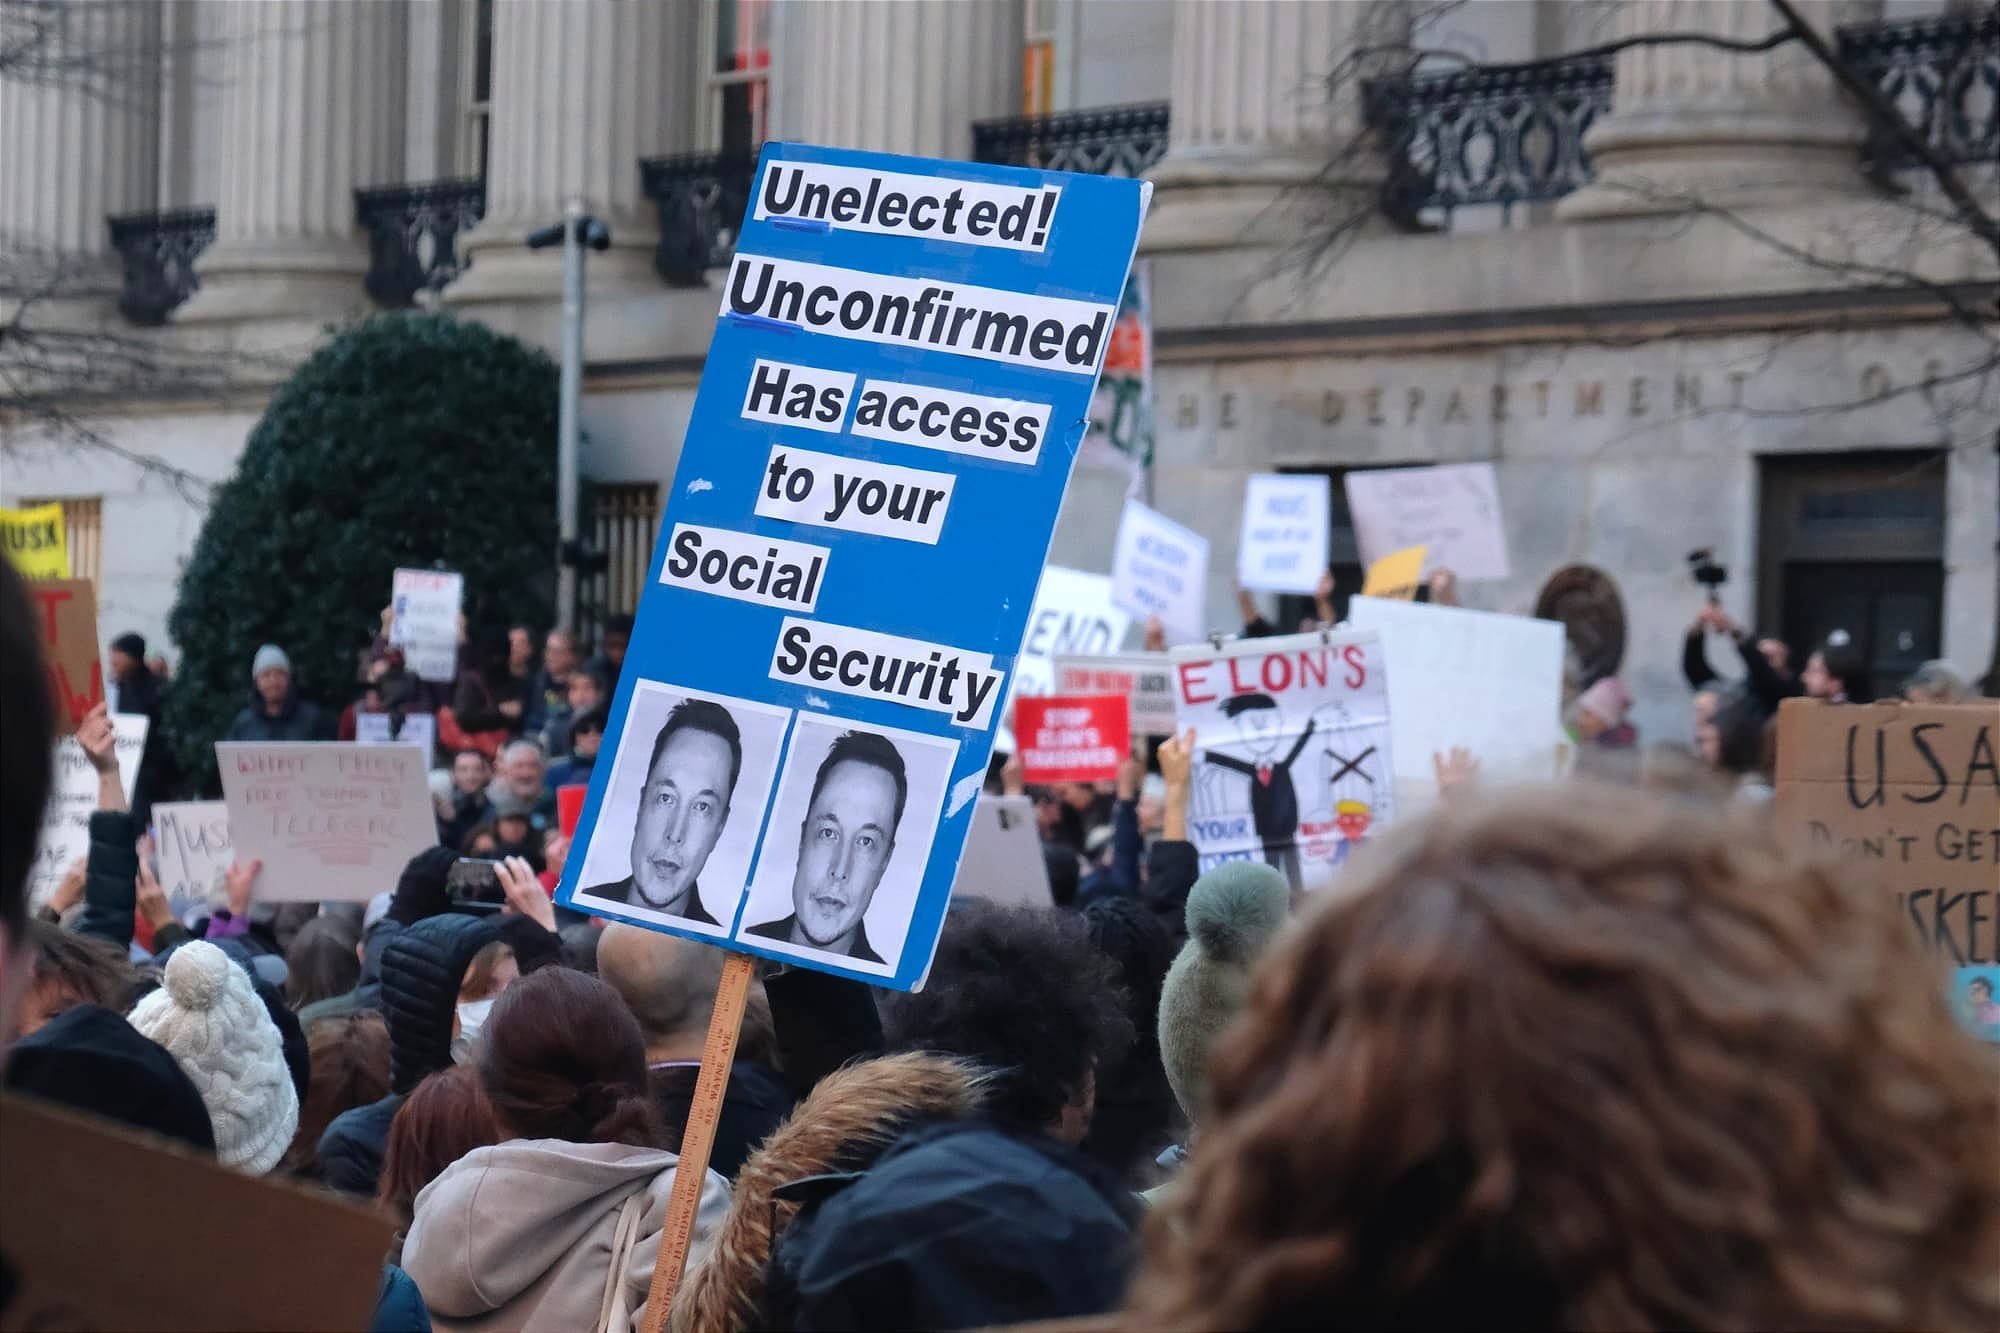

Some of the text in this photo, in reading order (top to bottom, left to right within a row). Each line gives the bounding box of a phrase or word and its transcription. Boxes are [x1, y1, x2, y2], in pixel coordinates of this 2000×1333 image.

[763, 166, 1058, 246] Unelected!
[729, 260, 1108, 367] Unconfirmed
[747, 366, 845, 424] Has
[855, 390, 1040, 453] access
[1321, 370, 1749, 427] DEPARTMENT
[767, 453, 945, 525] to your
[668, 530, 822, 604] Social
[1026, 608, 1111, 655] END
[777, 626, 996, 722] Security
[1179, 644, 1366, 704] ELON'S
[1036, 727, 1099, 748] ELON'S
[1044, 707, 1092, 728] STOP
[1023, 747, 1117, 768] TAKEOVER
[1846, 723, 2000, 809] USA
[1194, 818, 1248, 841] YOUR
[673, 1178, 698, 1260] HARDWARE
[709, 1062, 726, 1100] WAYNE
